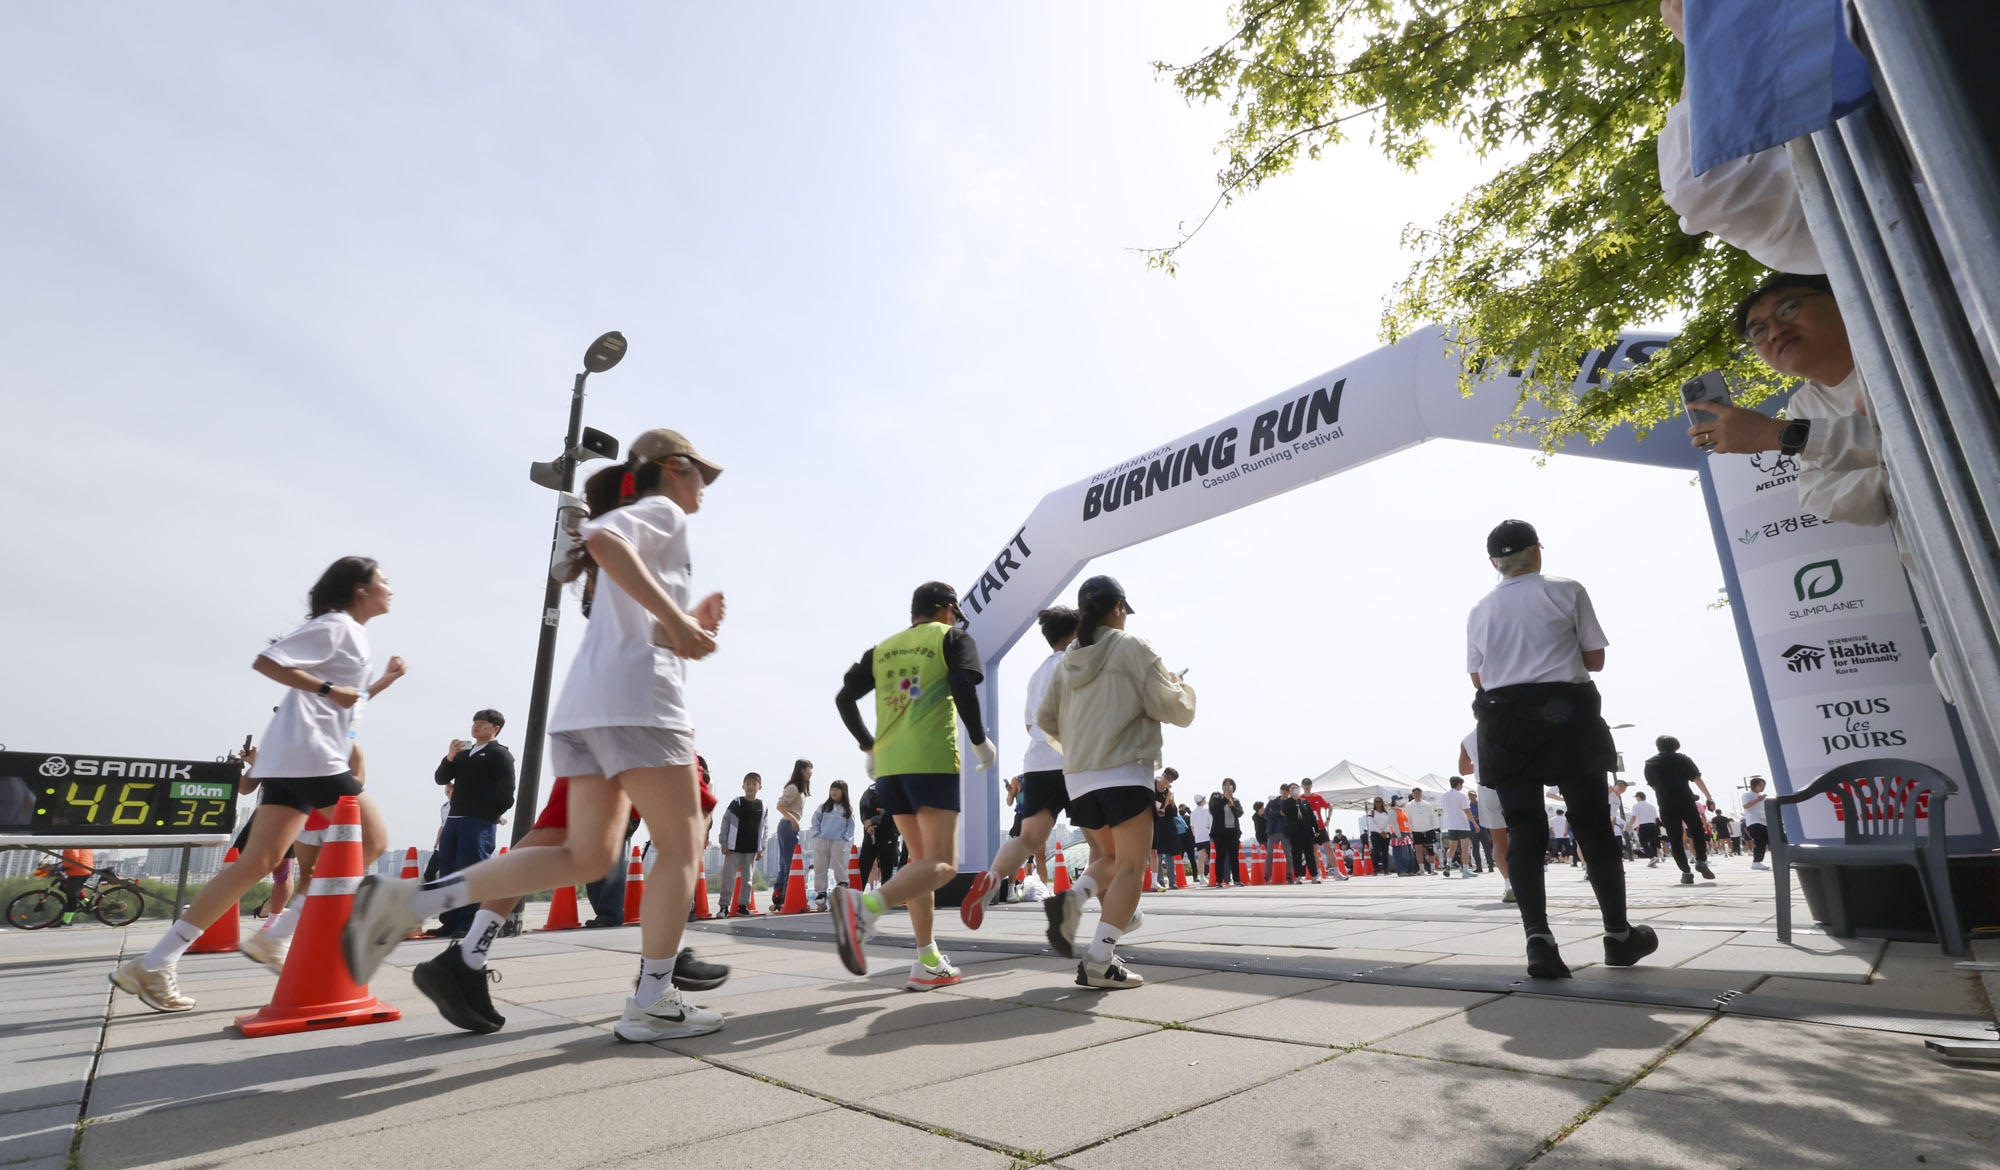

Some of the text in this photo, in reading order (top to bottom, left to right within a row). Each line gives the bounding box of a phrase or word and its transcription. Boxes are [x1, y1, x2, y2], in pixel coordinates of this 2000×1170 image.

[1083, 378, 1346, 522] BURNING RUN
[1202, 425, 1344, 489] Casual Running Festival
[1762, 513, 1834, 538] 김정문
[1789, 599, 1865, 620] SLIMPLANET
[1829, 641, 1897, 659] Habitat
[1833, 654, 1899, 667] for Humanity
[1835, 667, 1858, 675] Korea
[1816, 698, 1890, 719] TOUS
[1845, 717, 1871, 732] les
[1822, 730, 1907, 755] JOURS
[73, 759, 193, 779] SAMIK
[179, 784, 223, 797] 10km
